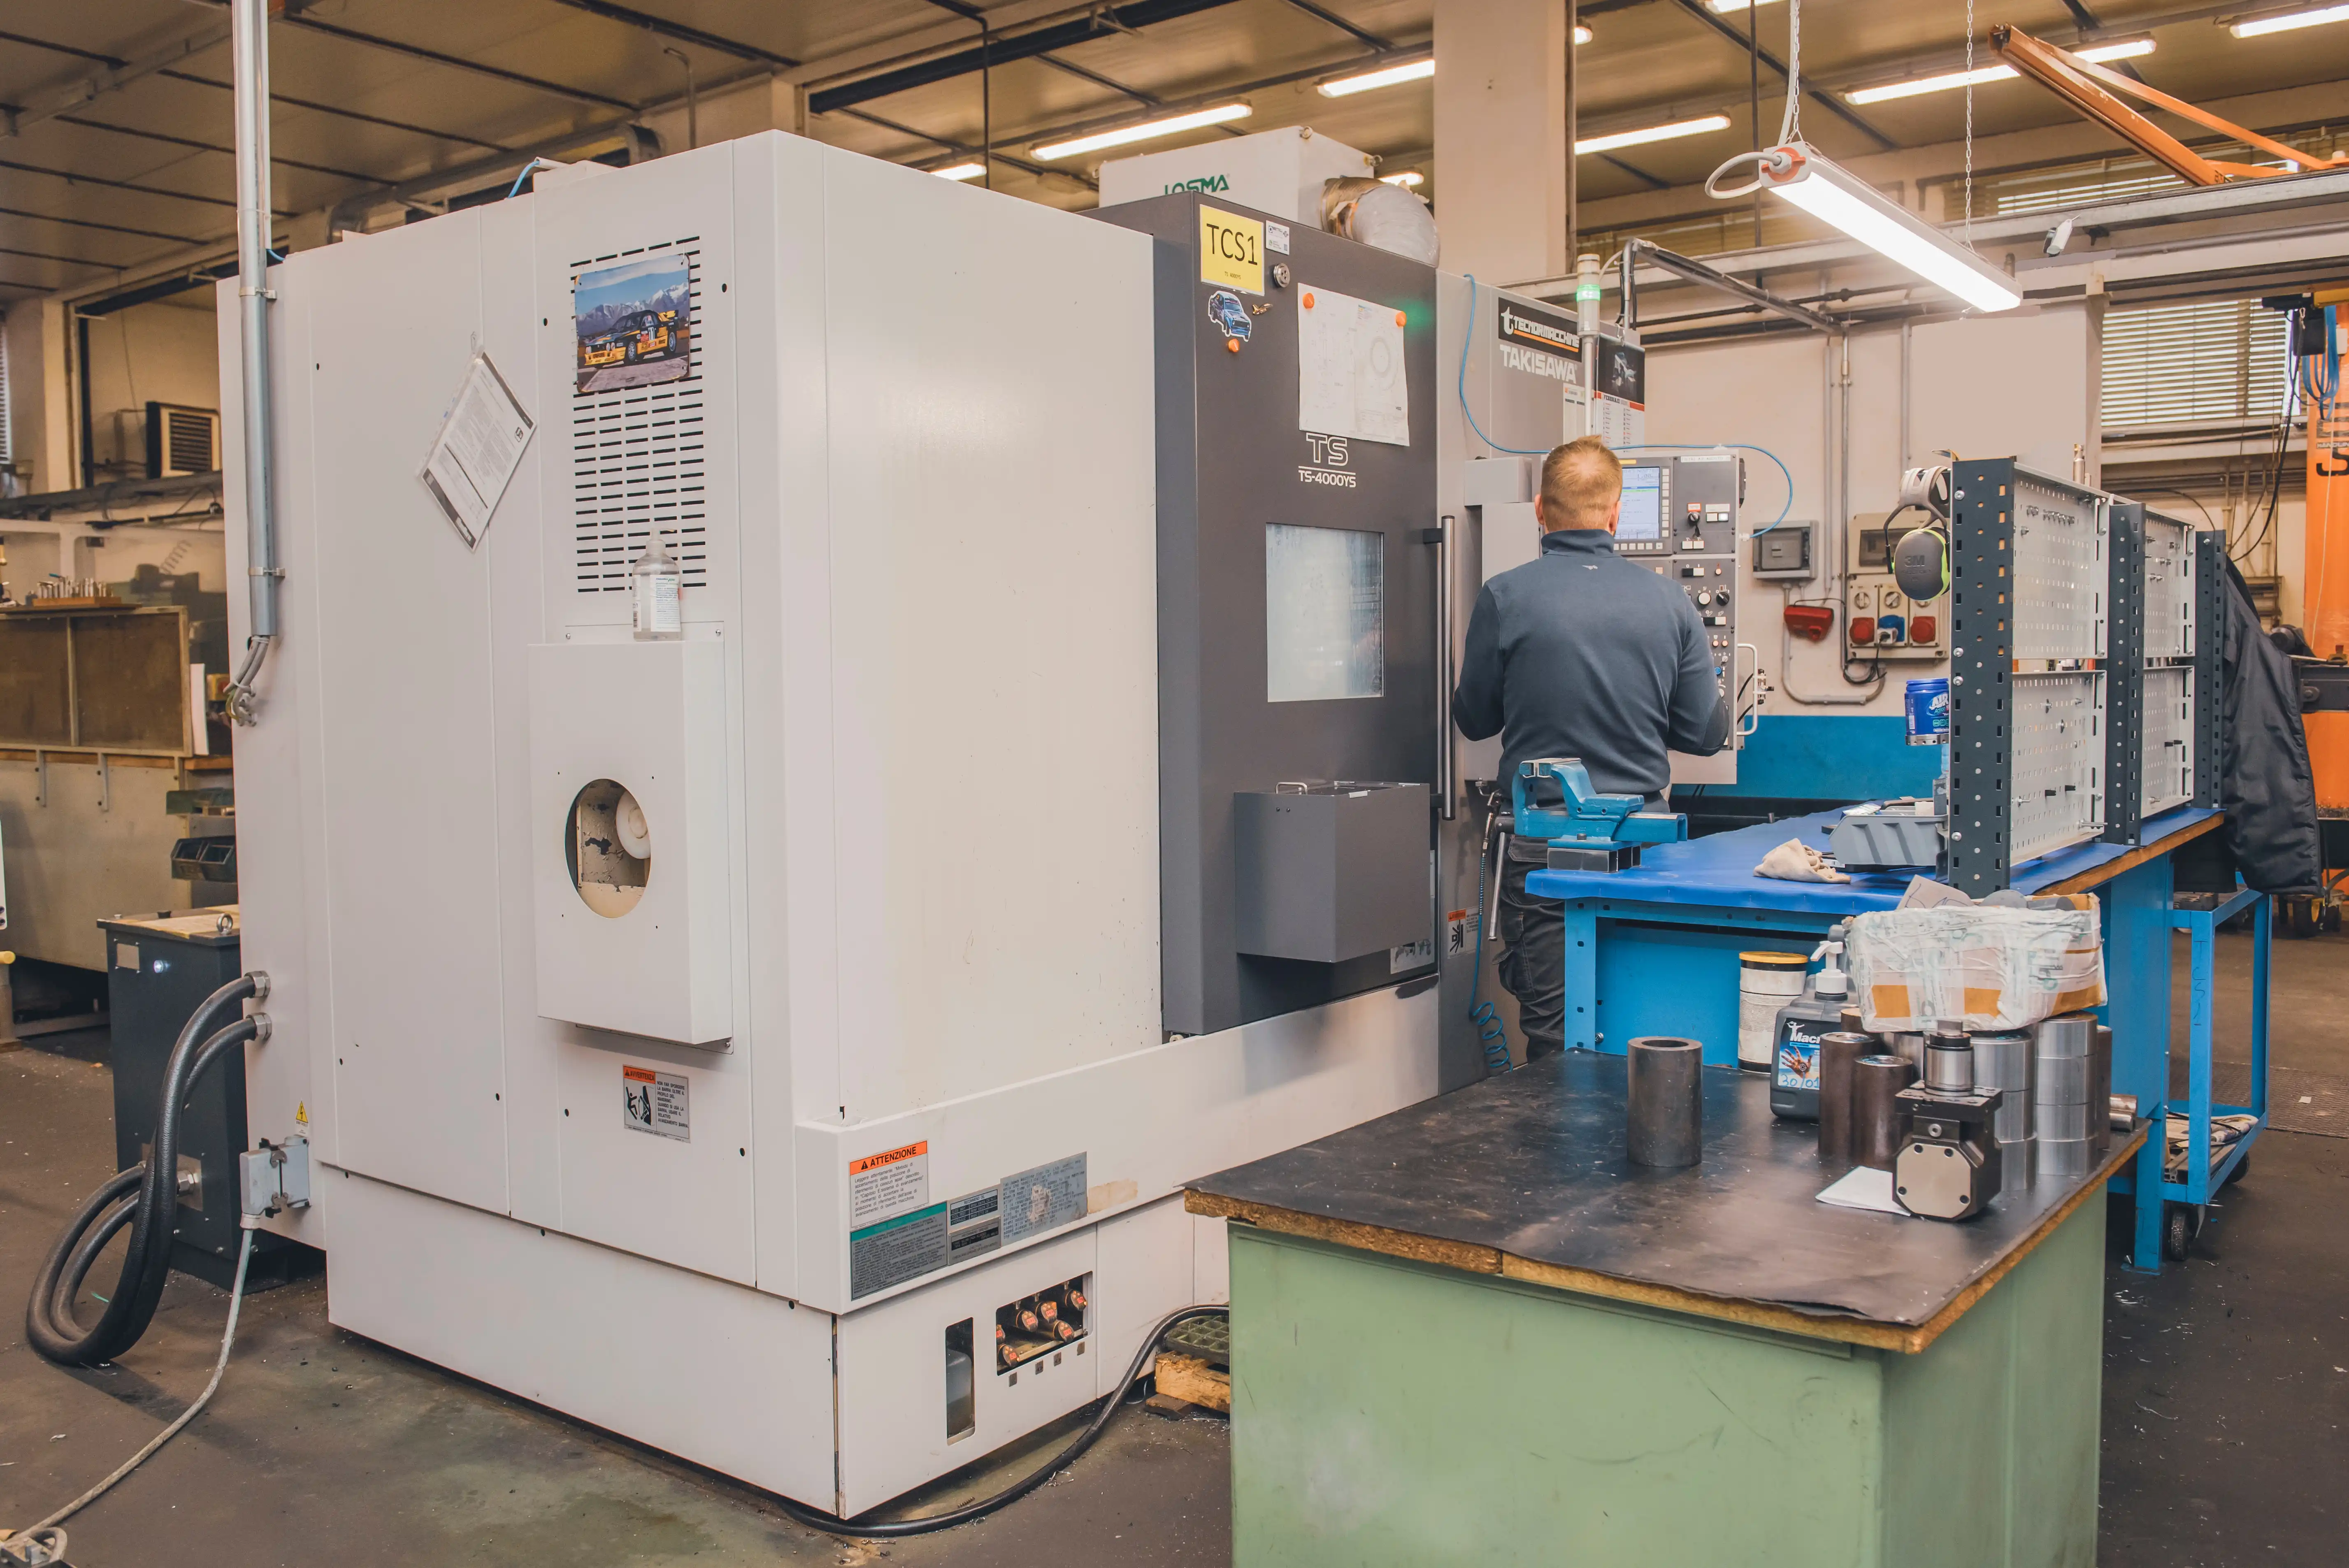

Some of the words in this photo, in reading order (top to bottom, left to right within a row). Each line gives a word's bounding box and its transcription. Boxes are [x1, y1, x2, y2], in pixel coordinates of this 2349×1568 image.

[1206, 223, 1257, 265] TCS1
[1500, 344, 1577, 384] TAKISAWA
[1306, 432, 1348, 467] TS
[1298, 470, 1356, 488] TS-4000YS
[1904, 555, 1925, 567] 3M
[1929, 692, 1949, 709] AIR
[630, 1070, 654, 1081] AVVERTENZA
[658, 1117, 678, 1126] AVANZAMENTO
[870, 1145, 916, 1167] ATTENZIONE
[854, 1175, 869, 1184] Leggere
[870, 1167, 892, 1178] attentamente
[855, 1178, 878, 1189] accertamento
[890, 1170, 905, 1179] posizione
[855, 1185, 873, 1194] riferimento
[905, 1171, 920, 1179] descritto
[855, 1203, 871, 1212] posizione
[878, 1195, 896, 1205] riferimento
[860, 1196, 876, 1204] momento
[883, 1189, 899, 1197] accertare
[855, 1206, 878, 1217] avanzamento
